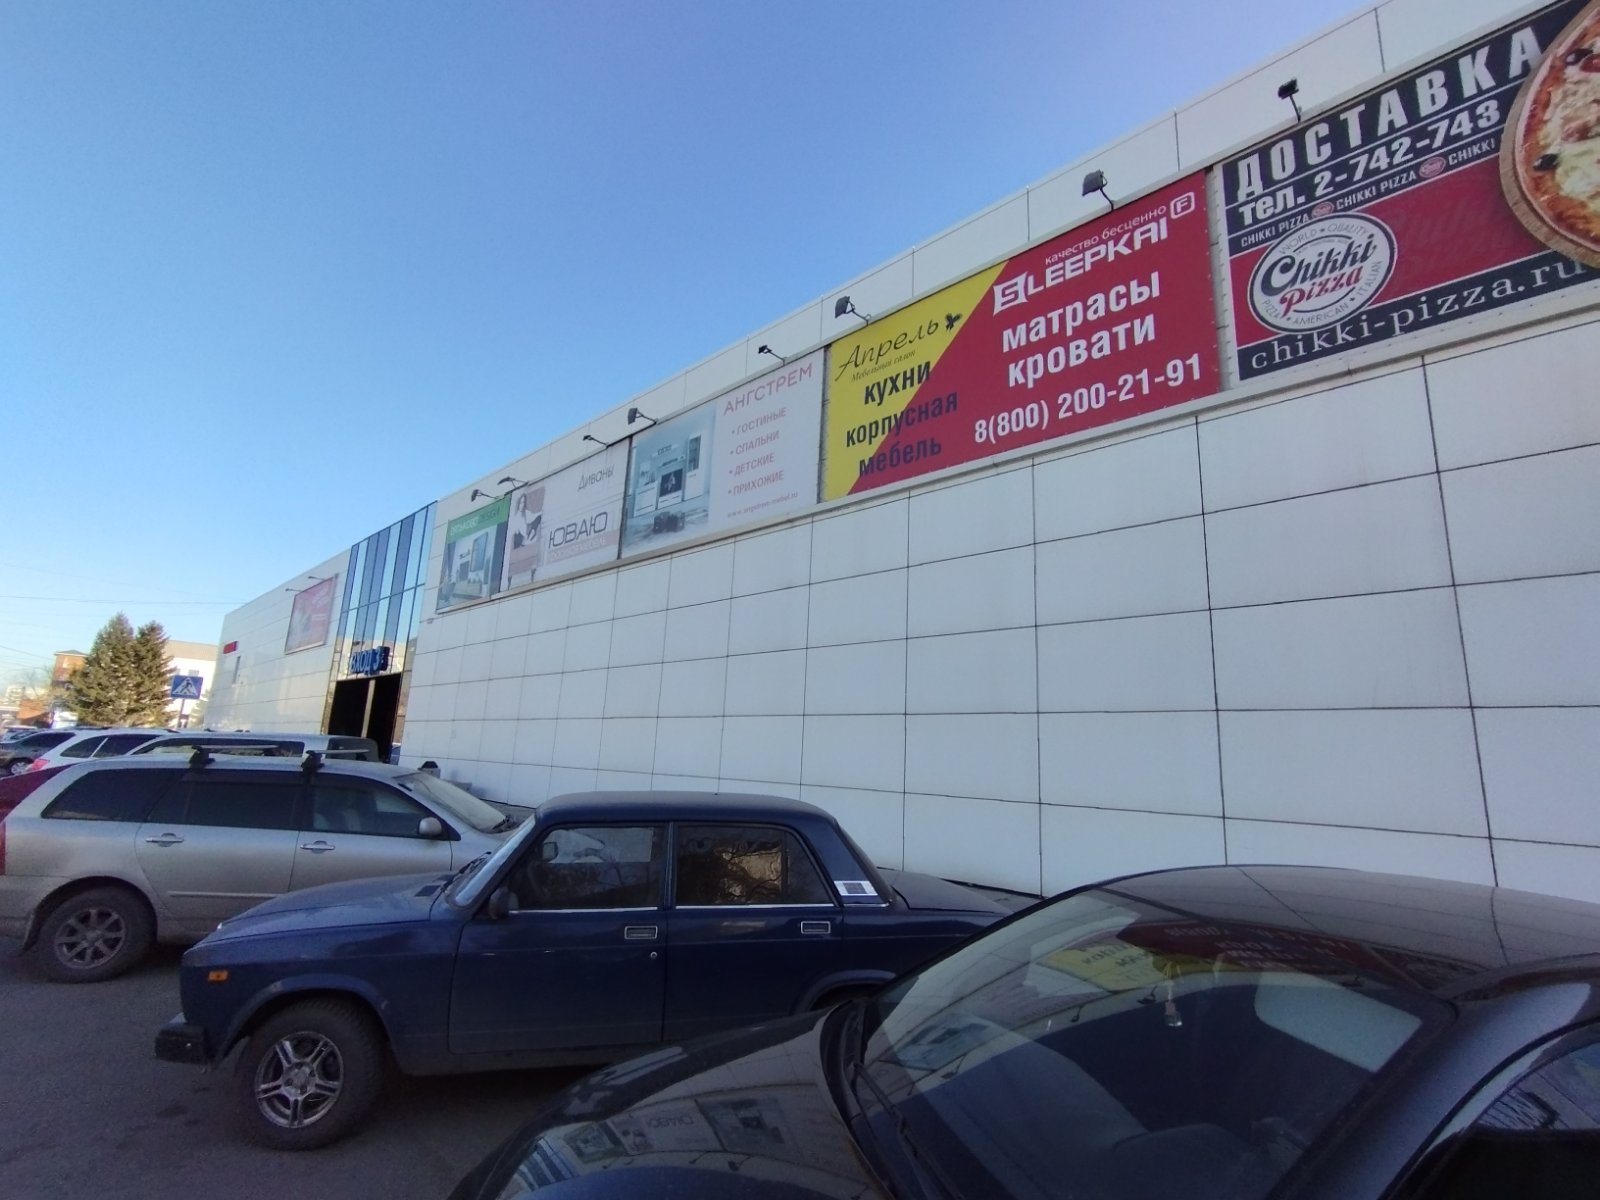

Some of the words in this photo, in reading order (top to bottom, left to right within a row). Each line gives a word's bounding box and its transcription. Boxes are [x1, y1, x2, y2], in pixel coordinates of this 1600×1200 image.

[1237, 26, 1544, 202] ДОСТАВКА
[1314, 99, 1500, 197] 2-742-743
[1241, 226, 1276, 248] CHIKKI
[1278, 213, 1309, 232] PIZZA
[1336, 186, 1376, 210] CHIKKI
[1381, 170, 1416, 192] PIZZA
[1448, 138, 1495, 165] CHIKKI
[1045, 235, 1099, 265] качество
[1102, 205, 1167, 240] бесценно
[1260, 233, 1377, 296] Chikki
[1279, 228, 1317, 254] WORLD
[1002, 271, 1160, 353] матрасы
[1251, 261, 1587, 369] chikki-pizza.ru
[1293, 303, 1349, 325] AMERICAN
[1357, 260, 1383, 296] ITALIAN
[834, 320, 939, 382] Апрель
[1008, 313, 1155, 389] кровати
[723, 362, 813, 416] АНГСТРЕМ
[864, 361, 931, 406] кухни
[974, 399, 1049, 445] 8(800)
[1057, 353, 1201, 421] 200-21-91
[735, 430, 780, 455] СПАЛЬНИ
[736, 406, 787, 435] ГОСТИНЫЕ
[846, 392, 958, 448] корпусная
[732, 470, 784, 496] ПРИХОЖИЕ
[733, 452, 775, 477] ДЕТСКИЕ
[859, 437, 942, 477] мебель
[549, 511, 608, 549] ЮВАЮ
